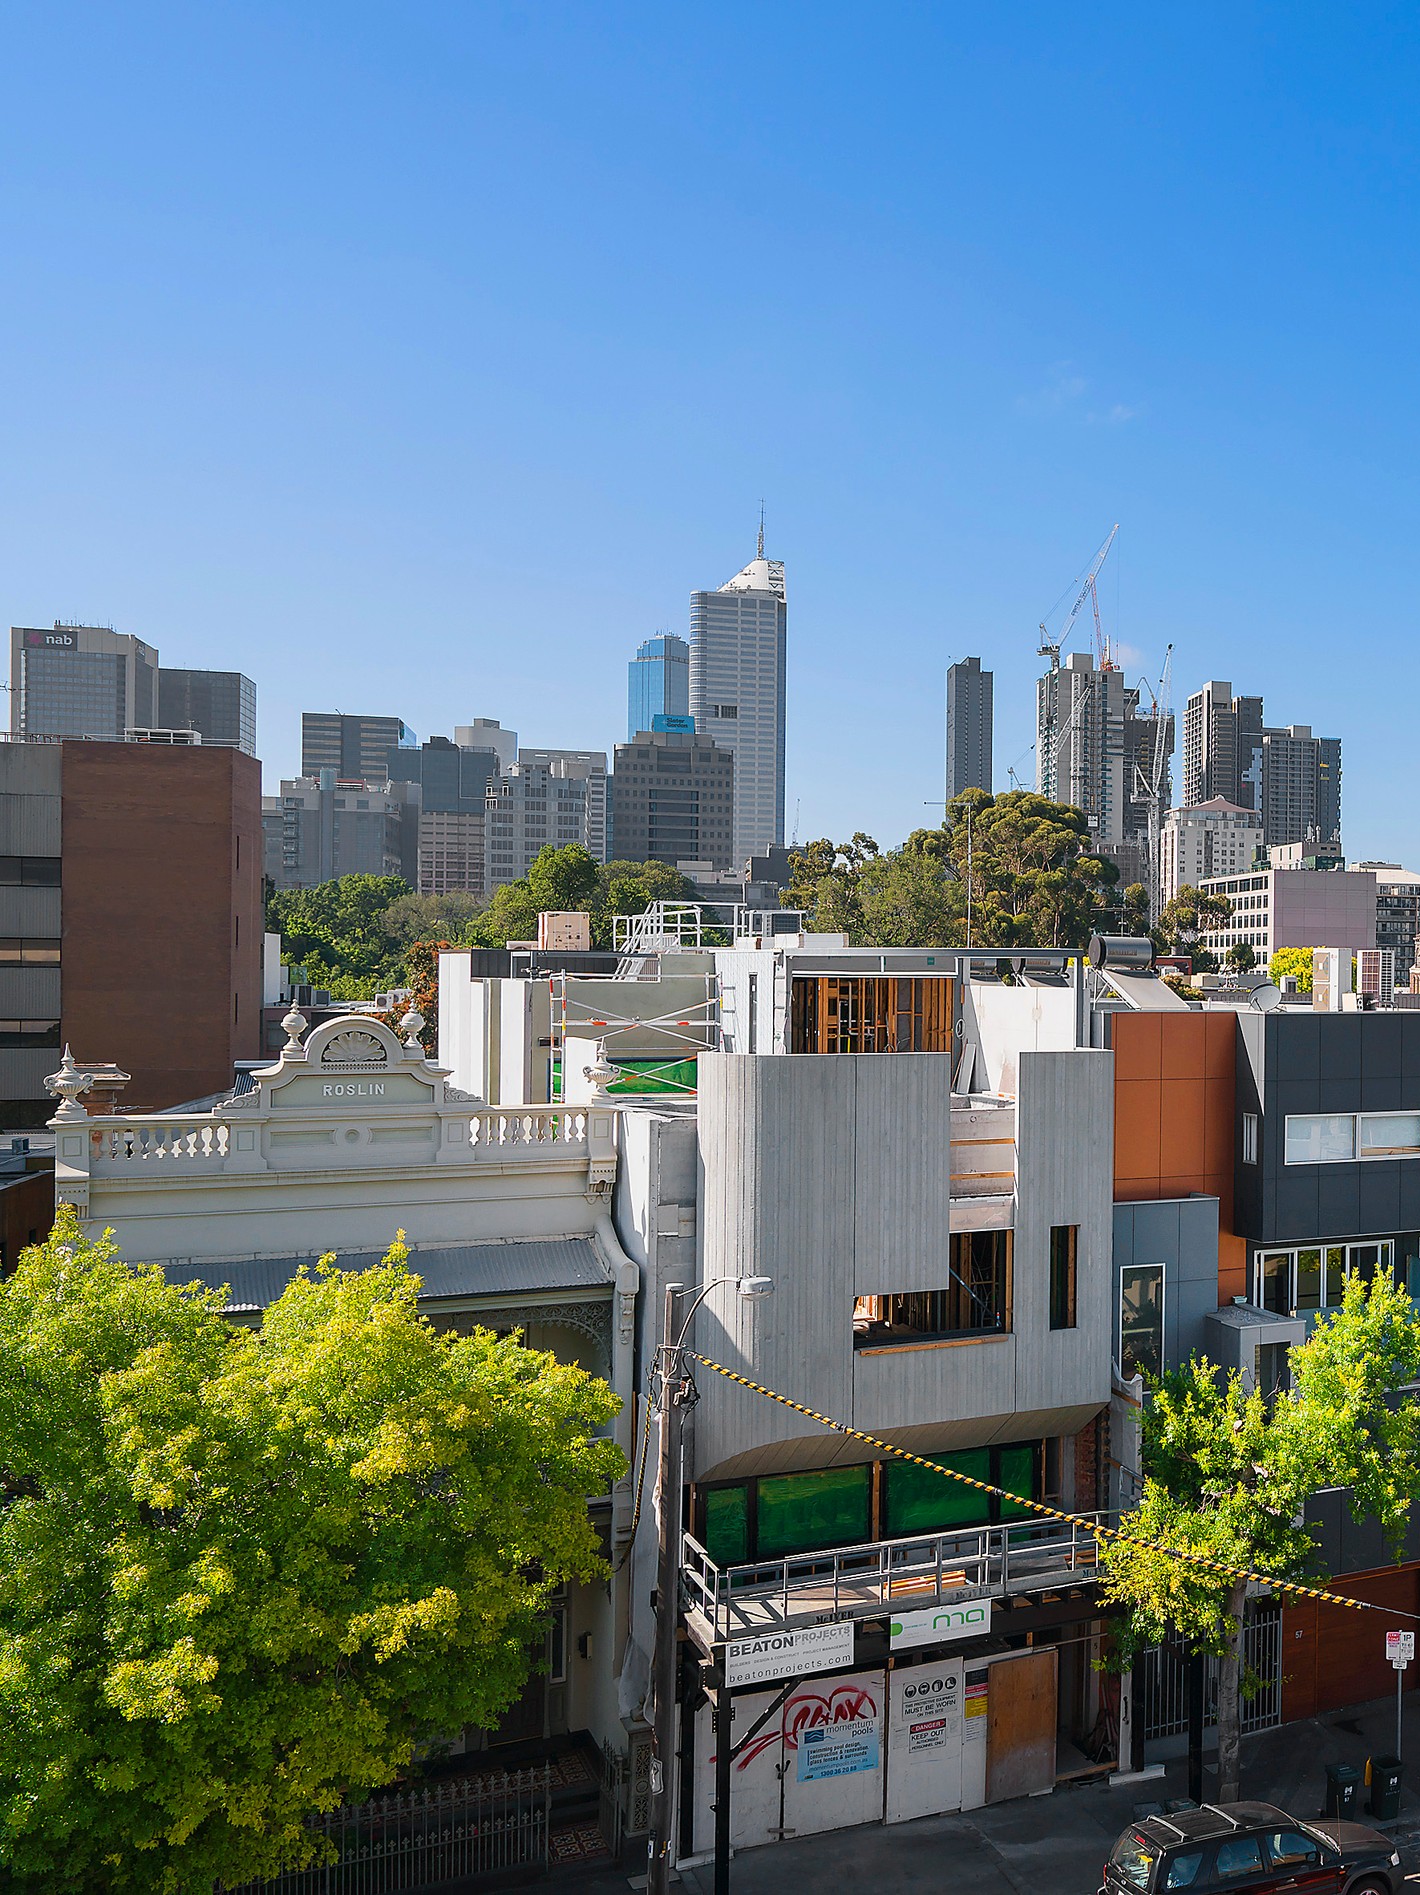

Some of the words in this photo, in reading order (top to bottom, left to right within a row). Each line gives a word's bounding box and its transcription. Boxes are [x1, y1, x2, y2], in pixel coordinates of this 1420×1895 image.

[46, 635, 73, 646] nab
[323, 1083, 385, 1096] ROSLIN
[1295, 1630, 1304, 1639] 57
[729, 1654, 851, 1683] beatonprojects.com
[905, 1706, 923, 1715] MUST
[936, 1699, 956, 1708] WORN
[826, 1719, 874, 1734] momentum
[915, 1721, 941, 1731] DANGER
[851, 1727, 874, 1738] pools
[911, 1732, 928, 1741] KEEP
[930, 1729, 944, 1737] OUT
[810, 1746, 833, 1754] swimming
[810, 1750, 839, 1760] construction
[844, 1750, 867, 1759] surrounds
